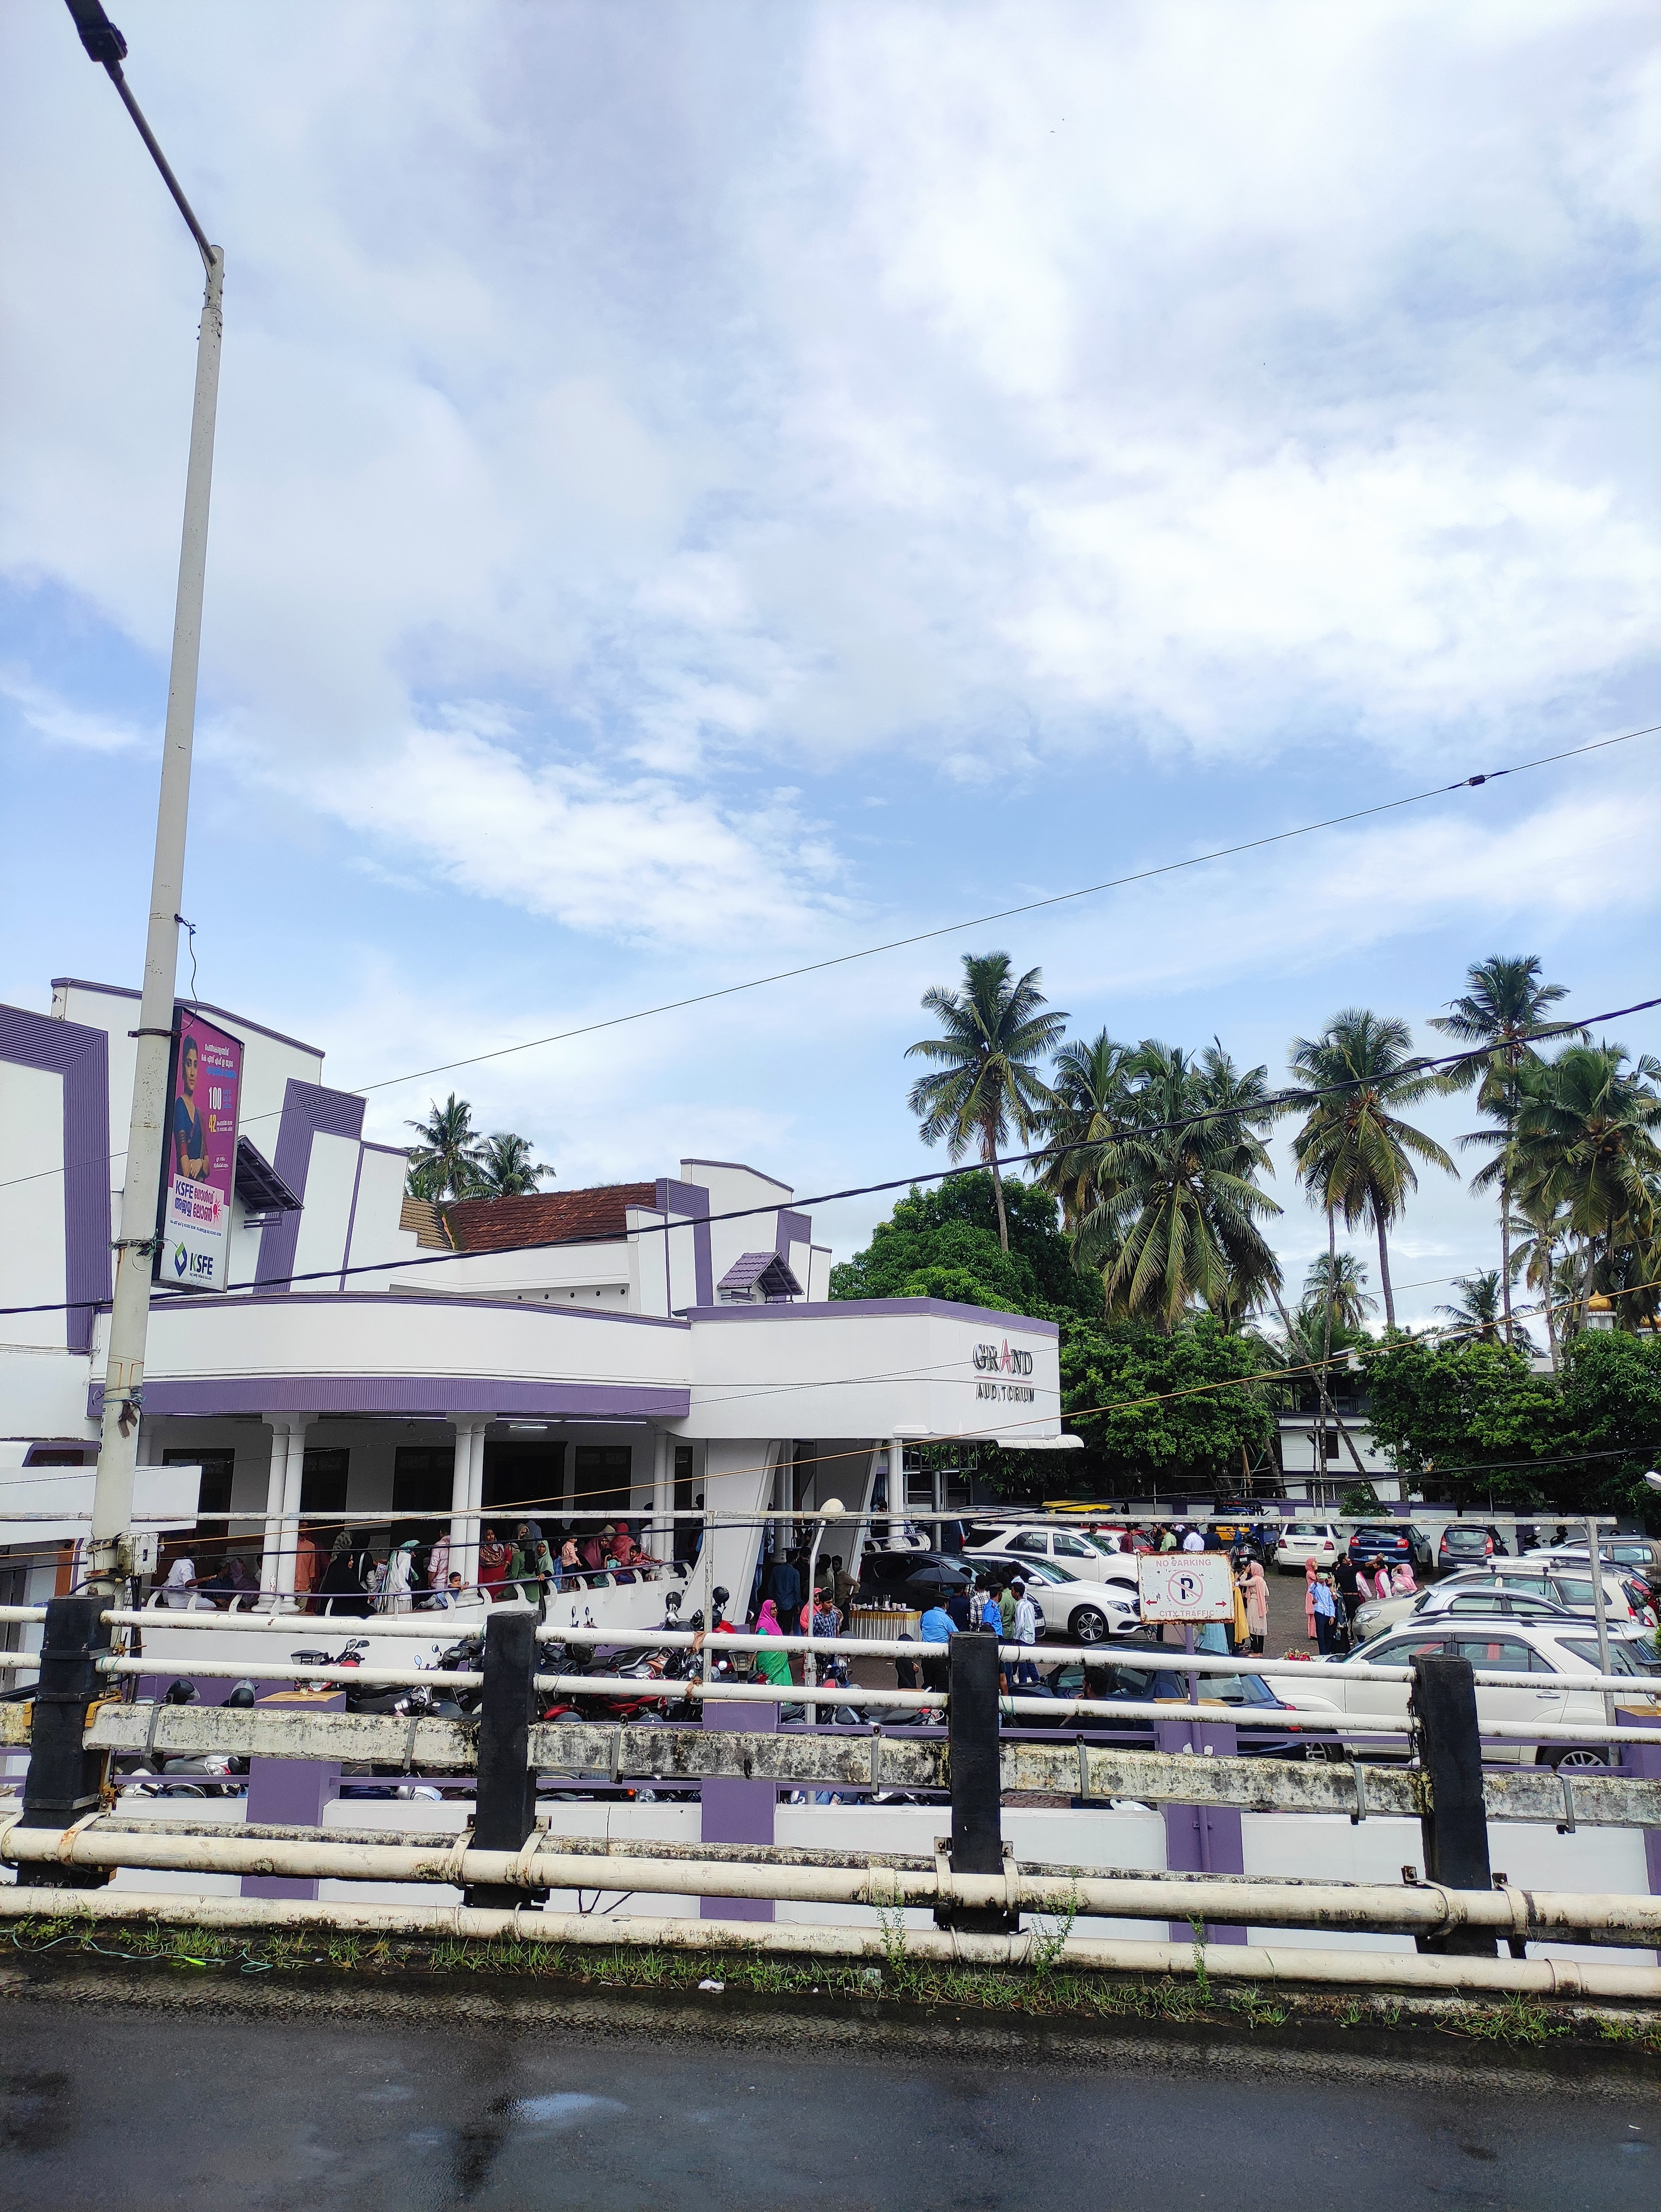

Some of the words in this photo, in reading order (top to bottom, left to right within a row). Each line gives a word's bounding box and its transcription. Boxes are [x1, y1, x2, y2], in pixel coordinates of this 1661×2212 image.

[209, 1086, 222, 1110] 100
[209, 1114, 216, 1133] 42
[176, 1180, 194, 1199] KSFE
[189, 1252, 213, 1275] KSFE
[973, 1338, 1033, 1375] GRAND
[975, 1382, 1035, 1403] AUDITORIUM
[1180, 1578, 1194, 1600] P
